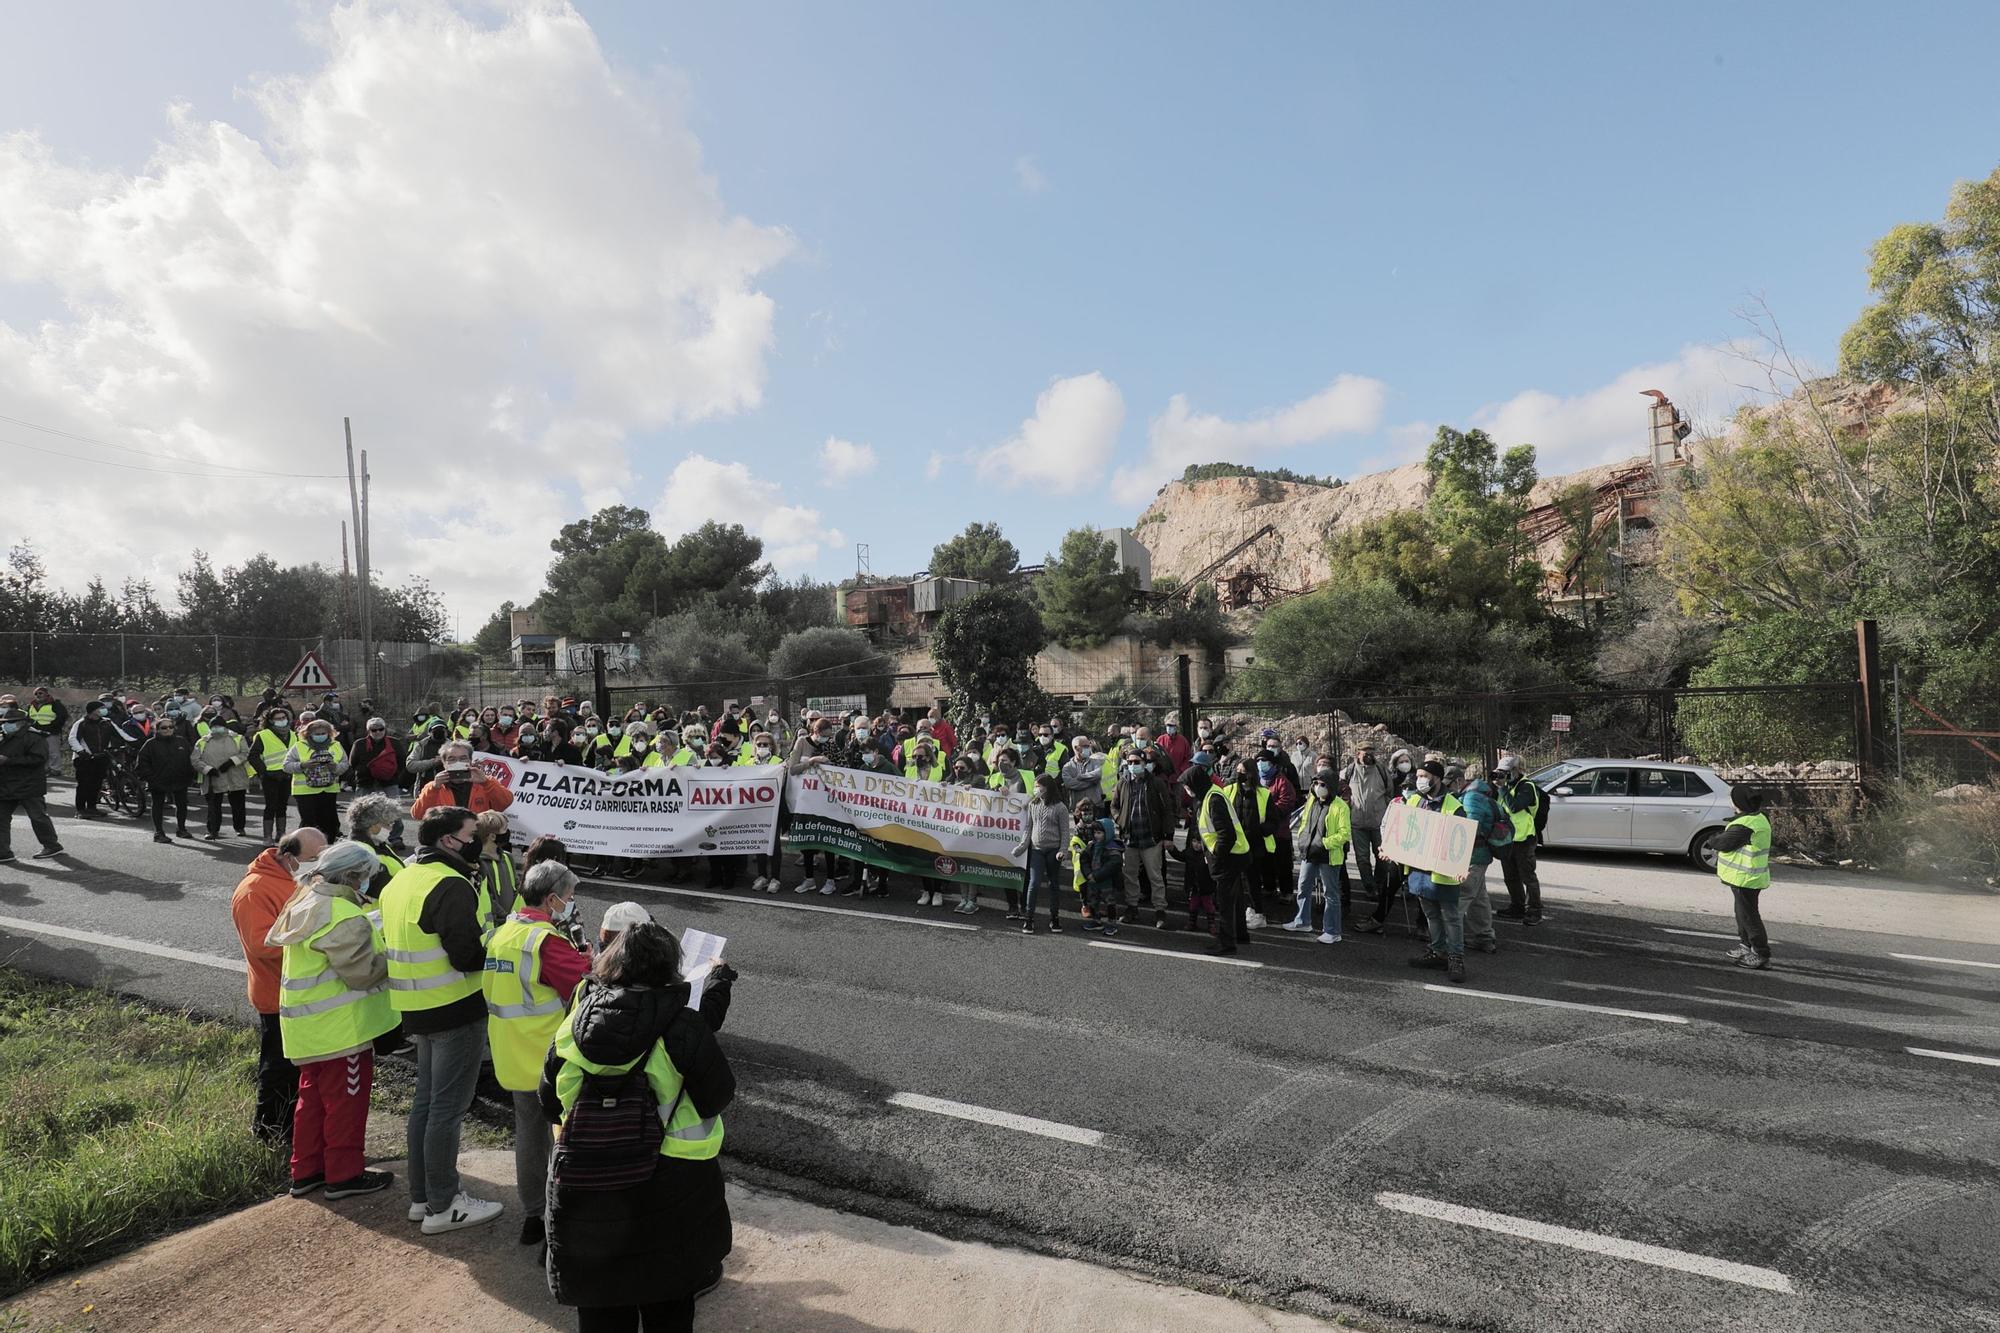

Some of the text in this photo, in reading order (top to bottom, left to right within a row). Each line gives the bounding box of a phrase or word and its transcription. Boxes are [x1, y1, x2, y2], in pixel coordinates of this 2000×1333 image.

[519, 771, 683, 797] PLATAFORMA
[690, 784, 775, 805] AIXÍ NO
[537, 793, 579, 810] TOQUEU
[579, 800, 592, 811] SA
[594, 800, 649, 814] GARRIGUETA
[802, 778, 819, 790] NI
[912, 804, 929, 817] NI
[932, 807, 1021, 831] ABOCADOR
[795, 821, 803, 830] la
[804, 821, 842, 834] defensa
[844, 827, 857, 838] del
[854, 808, 892, 821] projecte
[894, 815, 905, 824] de
[907, 818, 960, 836] restauració
[977, 830, 1020, 843] possible
[817, 833, 820, 842] i
[823, 834, 836, 844] els
[838, 836, 863, 852] barris
[960, 865, 1022, 880] PLATAFORMA CIUTADANA
